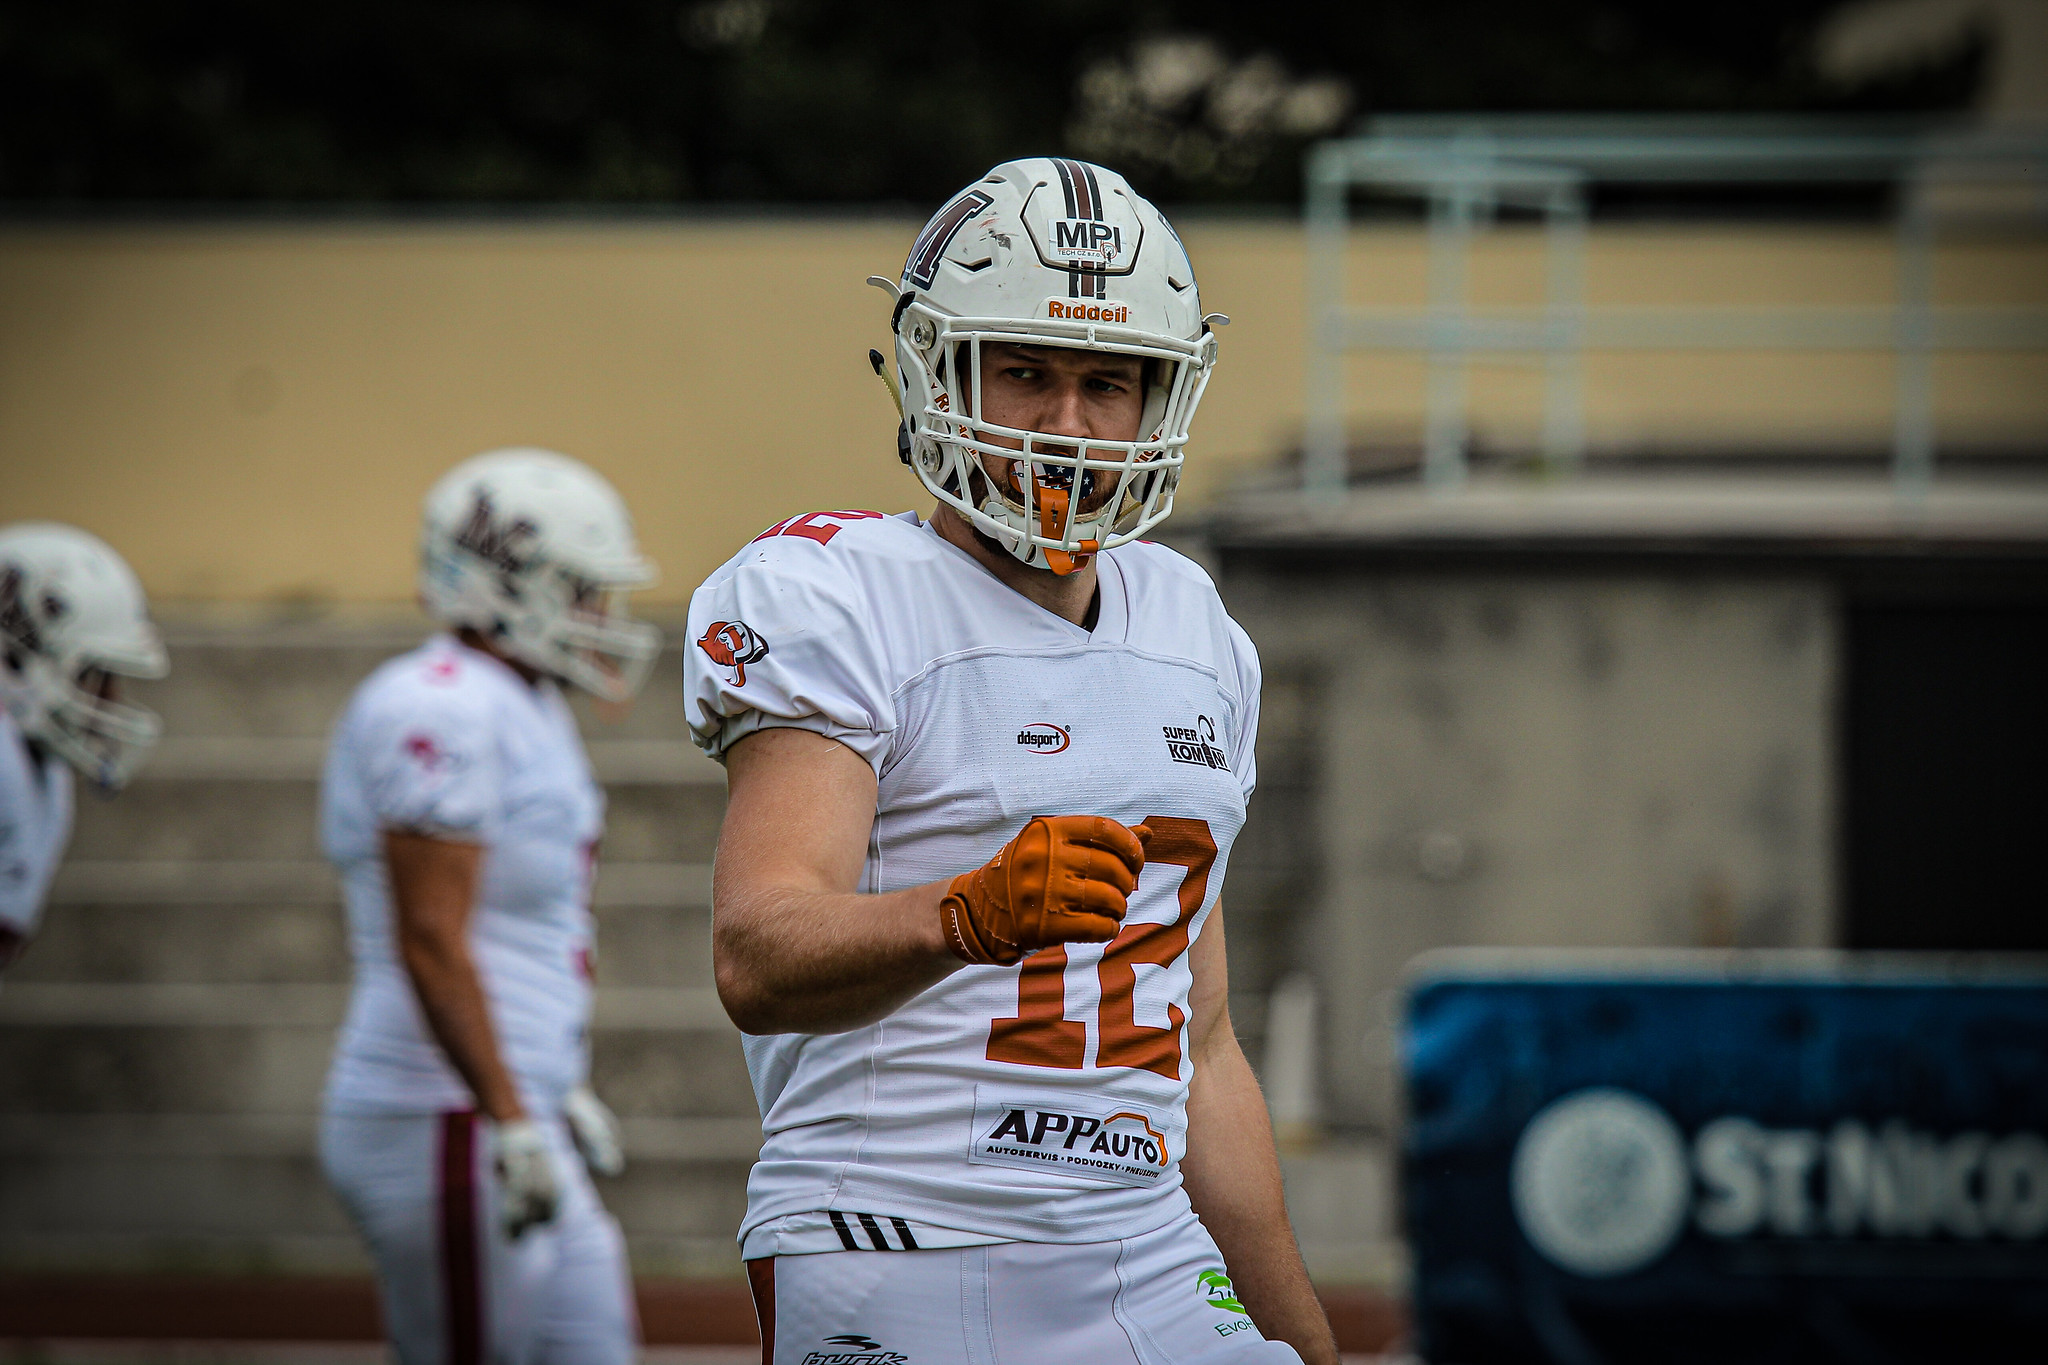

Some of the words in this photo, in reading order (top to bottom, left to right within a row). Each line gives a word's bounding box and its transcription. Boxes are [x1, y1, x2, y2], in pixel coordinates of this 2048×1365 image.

[1056, 221, 1122, 254] MPI
[1048, 300, 1128, 324] Riddell
[1017, 730, 1061, 749] ddsport
[1162, 726, 1199, 742] SUPER
[986, 1145, 1059, 1162] AUTOSERVIS
[1067, 1156, 1122, 1173] PODVOZKY
